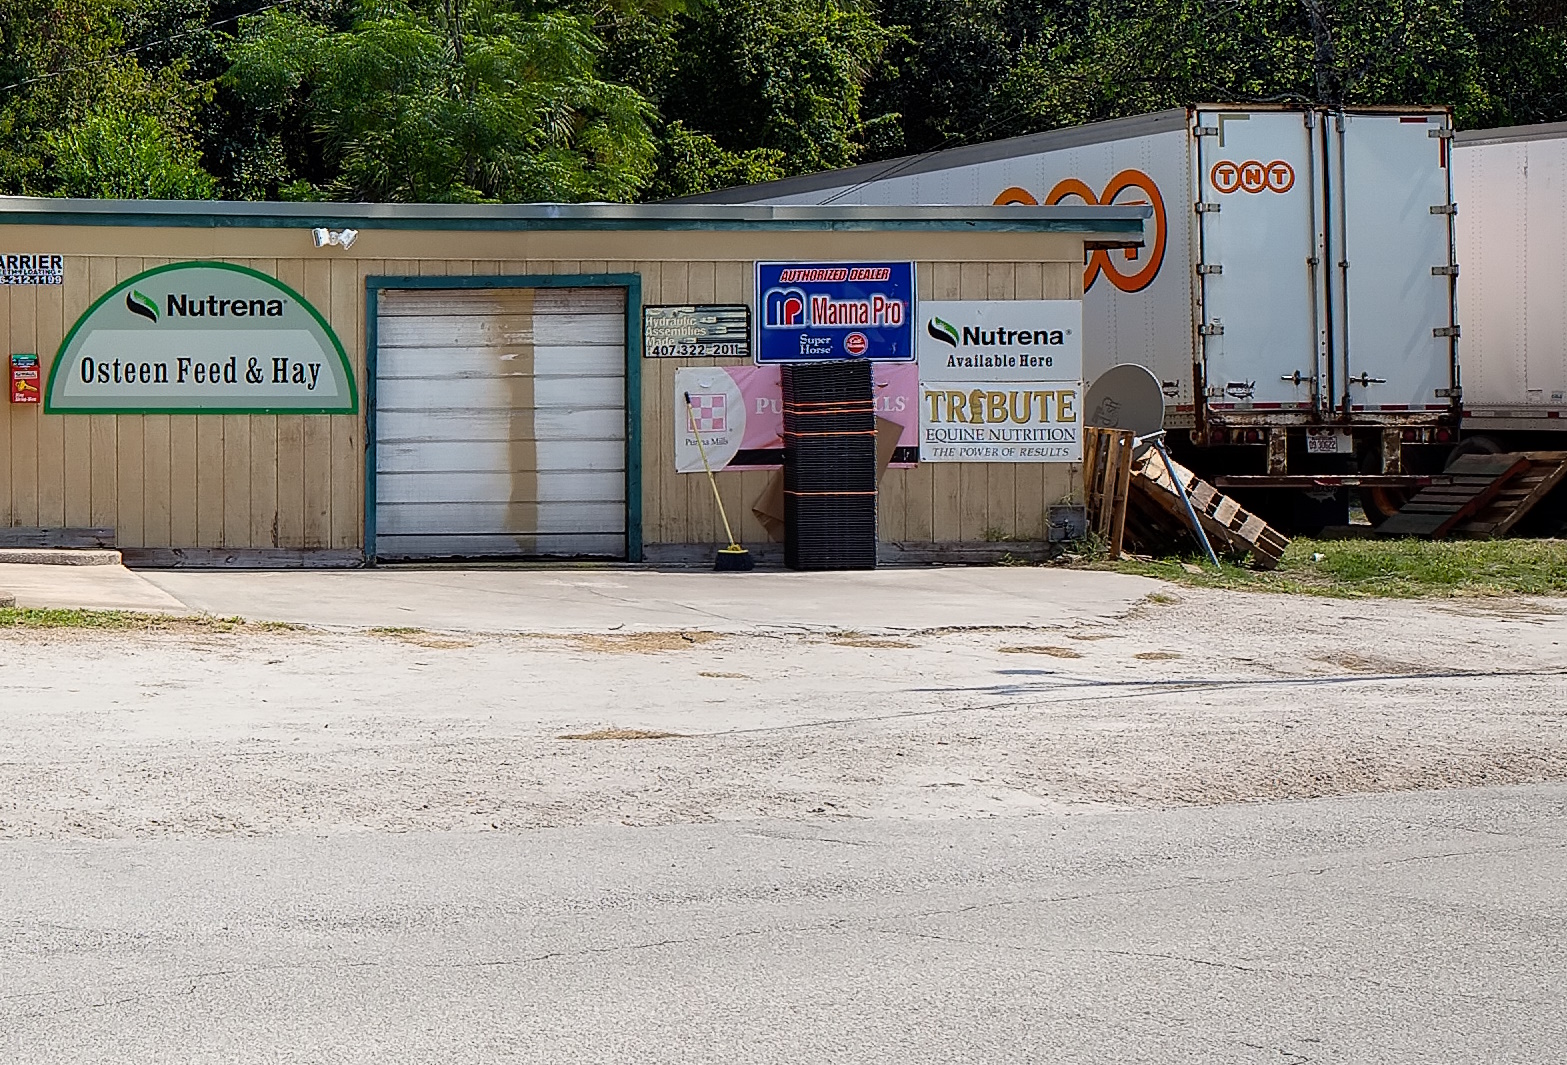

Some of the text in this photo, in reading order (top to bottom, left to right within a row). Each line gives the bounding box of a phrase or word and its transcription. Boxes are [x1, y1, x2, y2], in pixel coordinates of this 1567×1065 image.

[780, 268, 891, 282] AUTHORIZED DEALER
[167, 294, 283, 317] Nutrena
[812, 296, 901, 325] Manna Pro
[645, 317, 697, 328] Hydraulic
[645, 327, 707, 336] Assemblies
[962, 326, 1064, 346] Nutrena
[645, 337, 675, 346] Made
[799, 334, 831, 346] Super
[799, 345, 830, 355] Horse
[947, 354, 1053, 367] Available Here
[81, 357, 321, 390] Osteen Feed & Hay
[925, 428, 1076, 443] EQUINE NUTRITION
[933, 447, 1069, 456] THE POWER OF RESULTS
